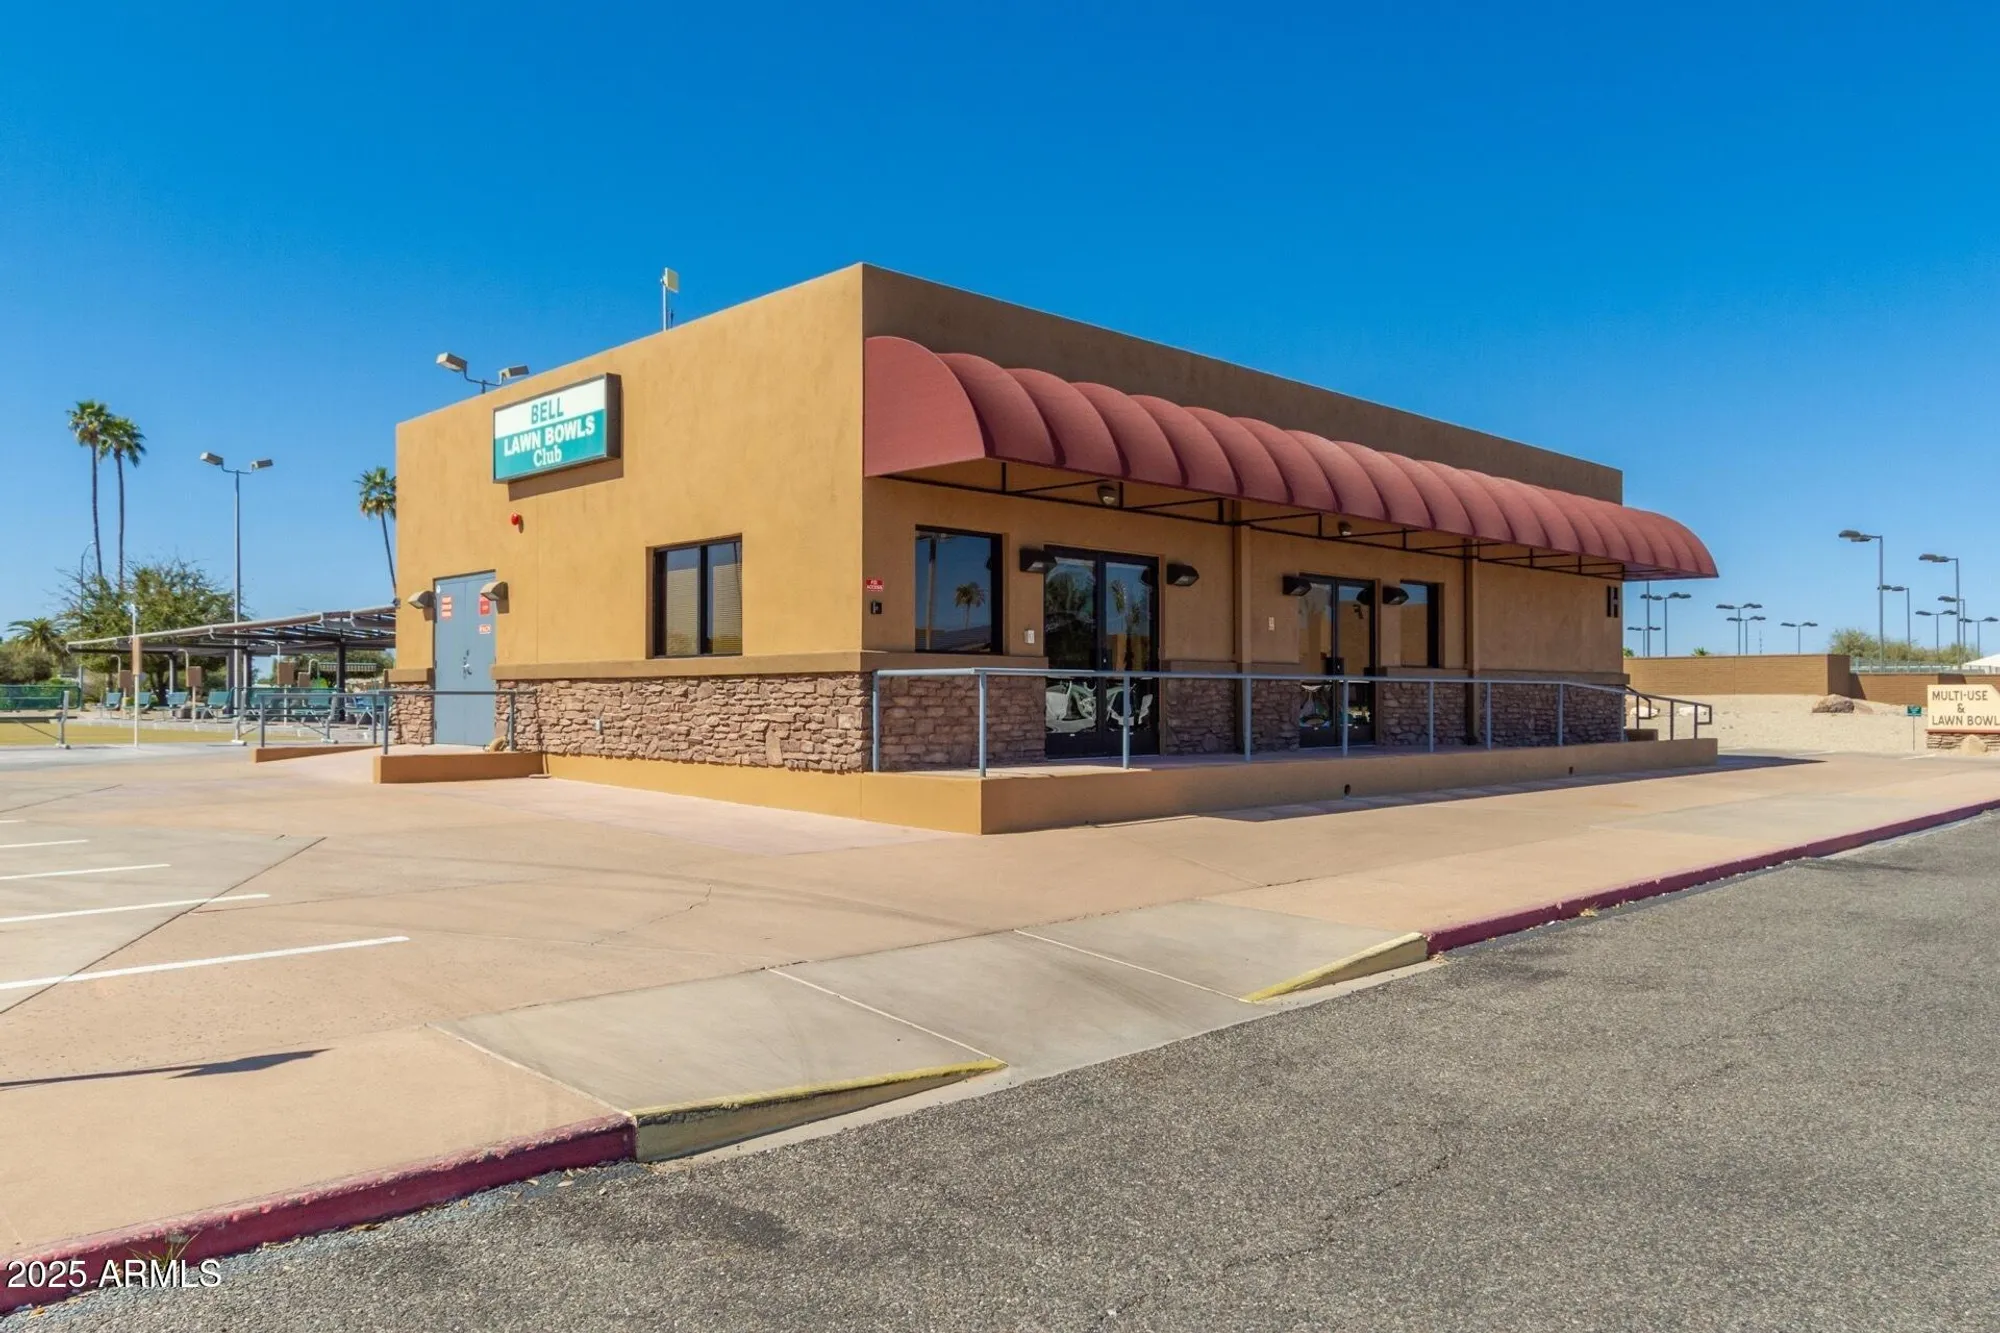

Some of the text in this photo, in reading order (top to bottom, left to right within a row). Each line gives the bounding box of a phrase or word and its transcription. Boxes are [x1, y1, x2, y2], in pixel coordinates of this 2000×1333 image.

[531, 398, 564, 424] BELL
[504, 415, 595, 456] LAWN BOWLS
[533, 444, 562, 467] Club
[1932, 690, 1988, 701] MULTI-USE
[1957, 702, 1965, 713] &
[1932, 715, 1963, 726] LAWN
